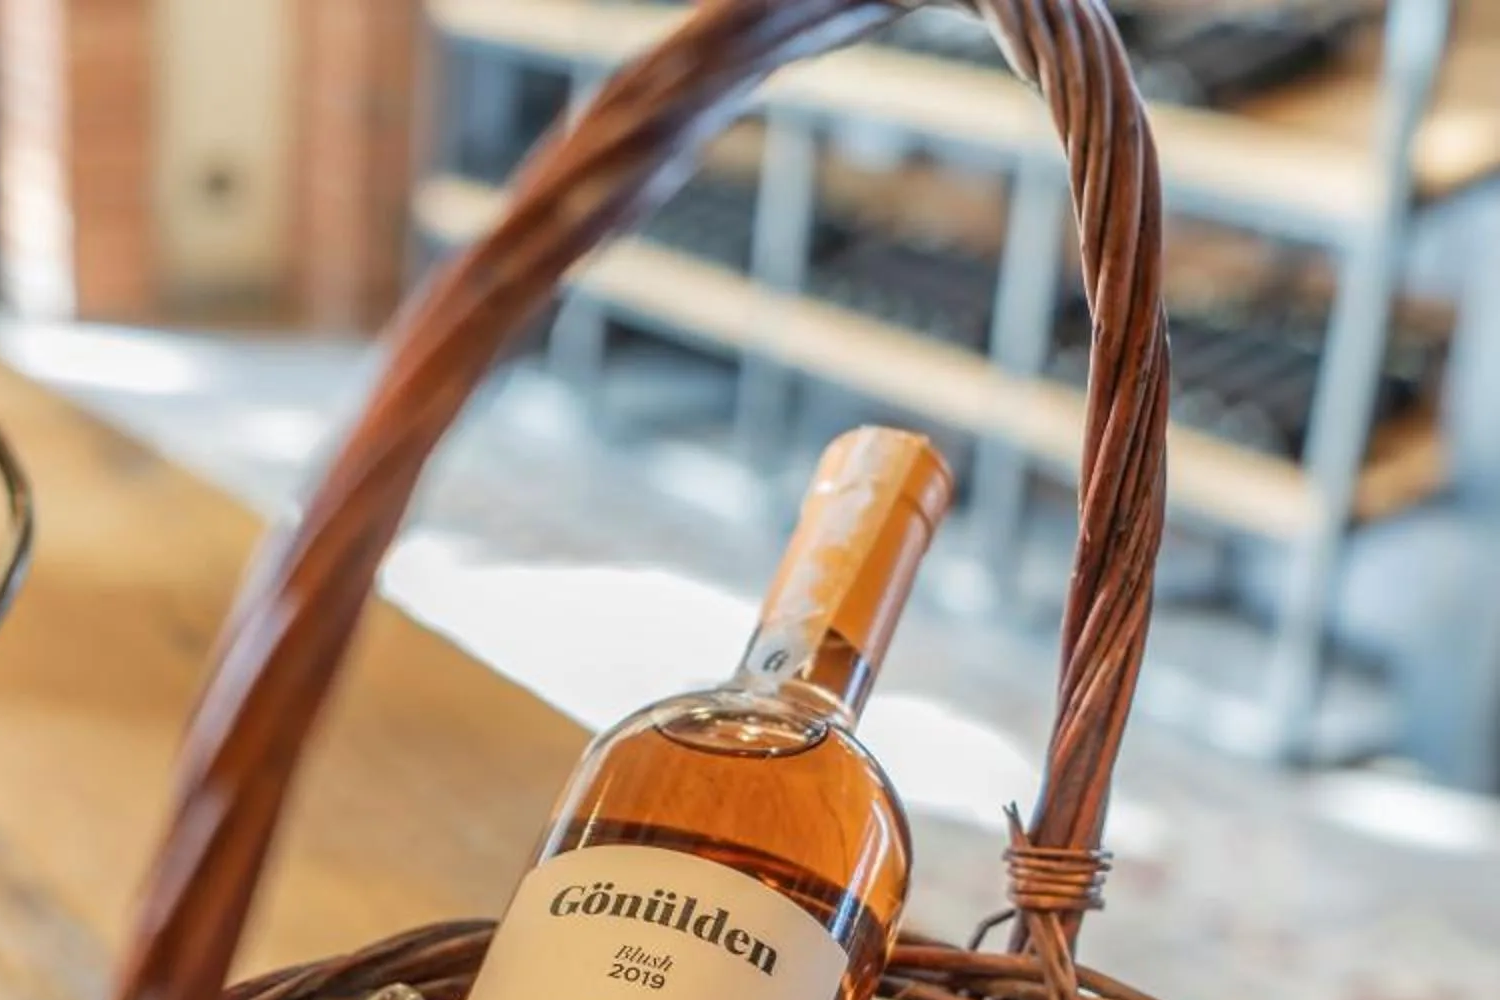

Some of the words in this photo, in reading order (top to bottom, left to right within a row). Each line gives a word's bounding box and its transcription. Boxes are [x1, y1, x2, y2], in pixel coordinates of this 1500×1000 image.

[549, 882, 778, 976] Gönülden
[614, 944, 674, 972] Blush
[607, 963, 666, 990] 2019
